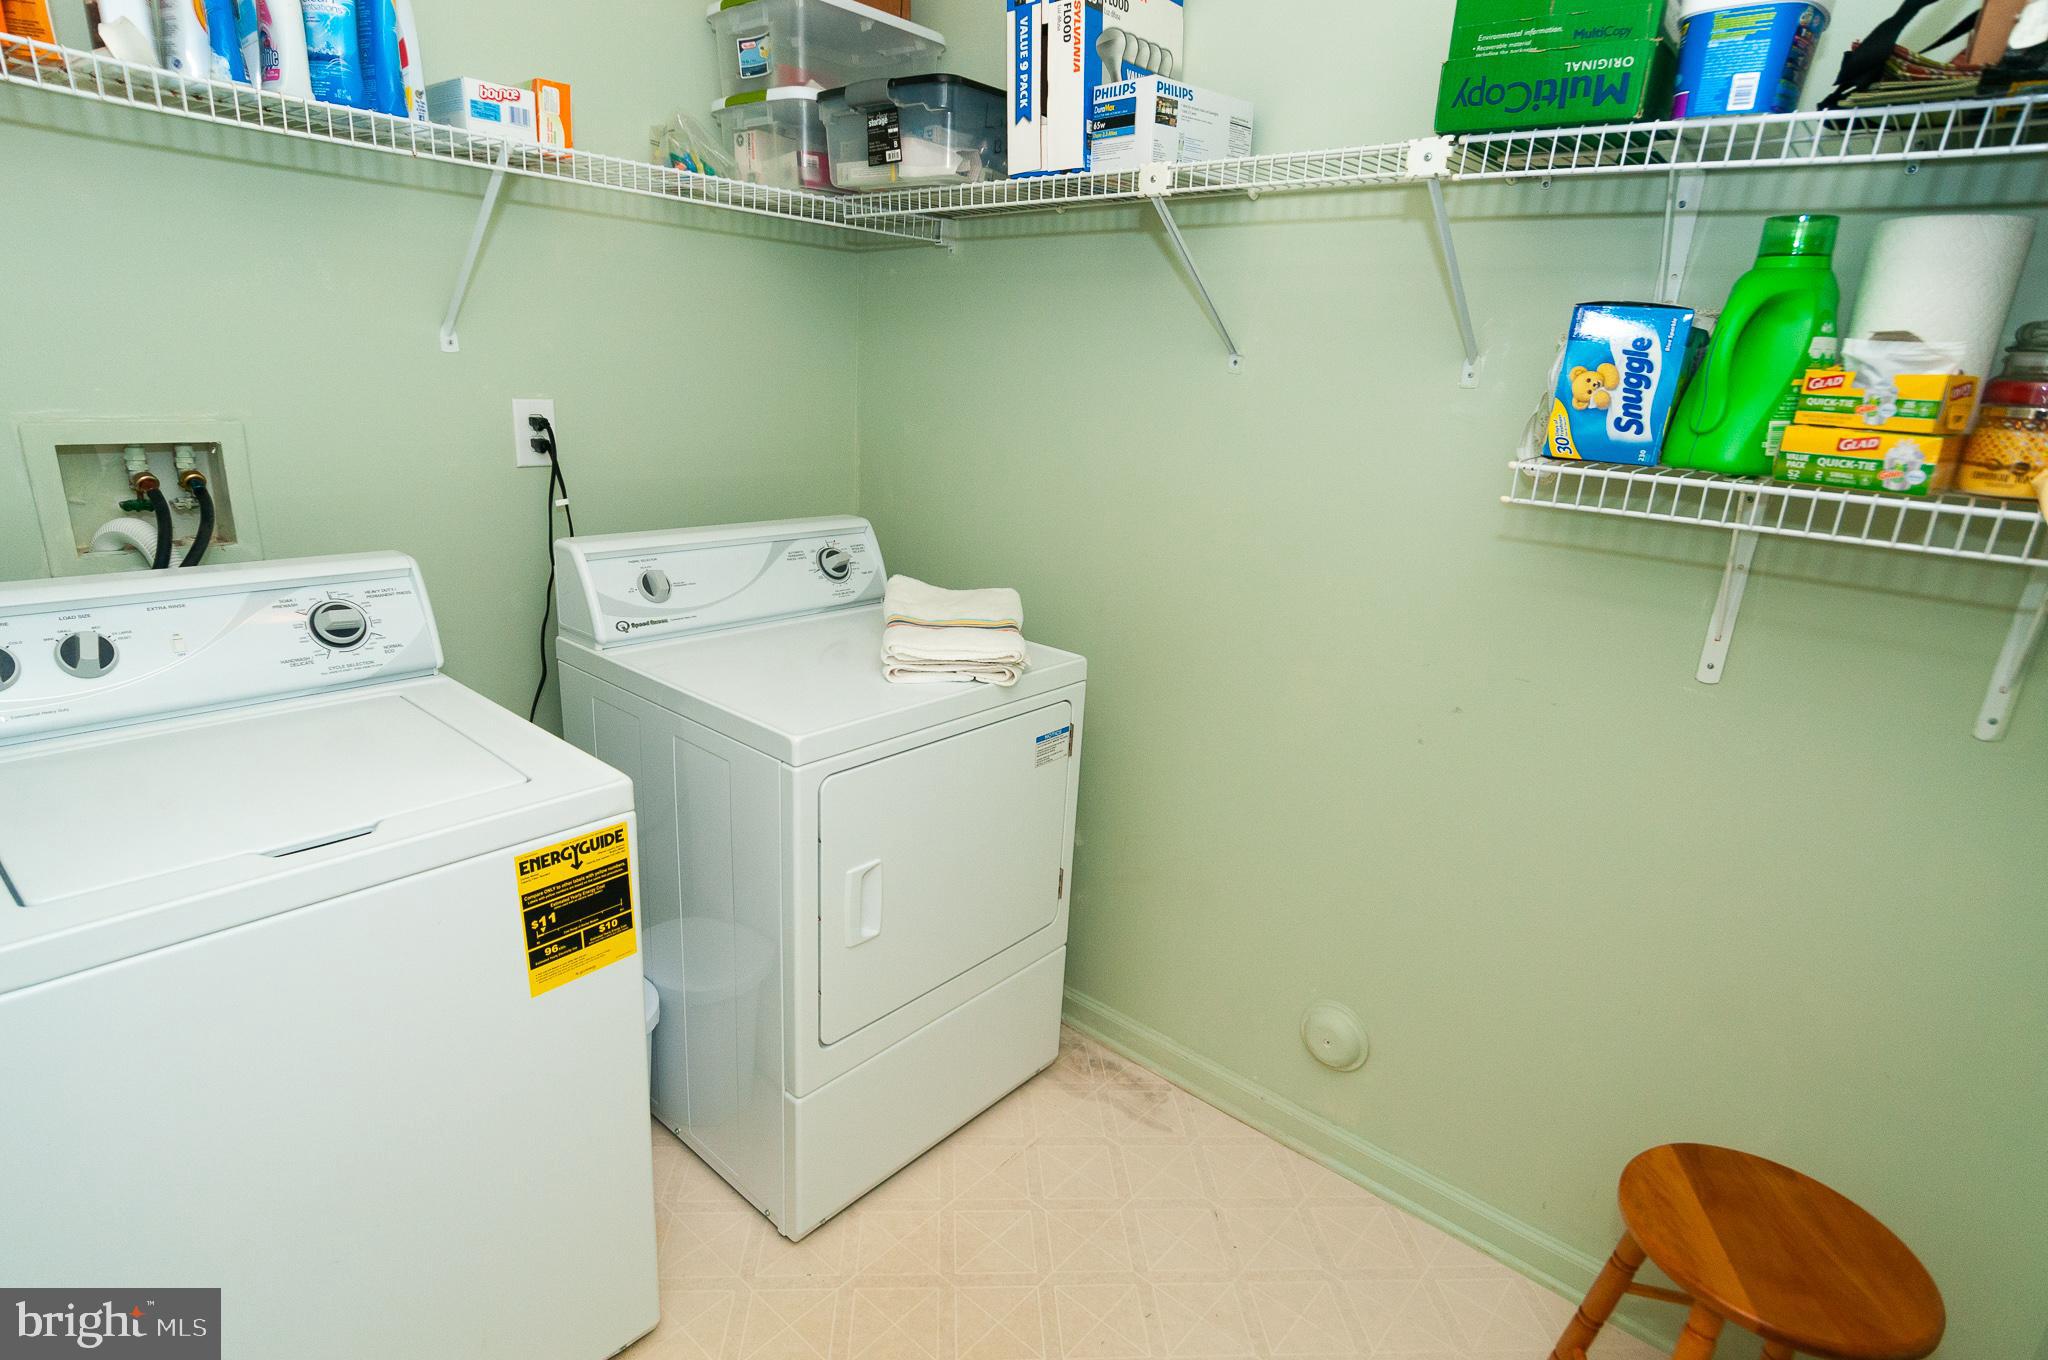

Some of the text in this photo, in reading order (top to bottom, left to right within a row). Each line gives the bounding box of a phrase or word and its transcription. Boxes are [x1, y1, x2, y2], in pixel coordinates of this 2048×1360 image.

[1063, 2, 1072, 43] FLOOD
[1073, 0, 1082, 73] SYLVANIA
[1573, 25, 1633, 40] MultiCopy
[1020, 16, 1029, 109] VALUE 9 PACK
[1564, 55, 1635, 73] ORIGINAL
[479, 84, 521, 102] bounce
[1095, 82, 1137, 101] PHILIPS
[1156, 80, 1194, 102] PHILIPS
[1451, 71, 1632, 114] MultiCopy
[1093, 121, 1106, 131] 65w
[1613, 336, 1654, 436] Snuggle
[1808, 375, 1845, 390] GLAD
[1555, 436, 1573, 455] 30
[1839, 437, 1880, 451] GLAD
[1637, 449, 1647, 462] 230
[1817, 457, 1878, 471] QUICK-TIE
[518, 828, 625, 876] ENERGYGUIDE
[531, 911, 557, 930] $11
[598, 919, 618, 933] $10
[544, 944, 559, 956] 96
